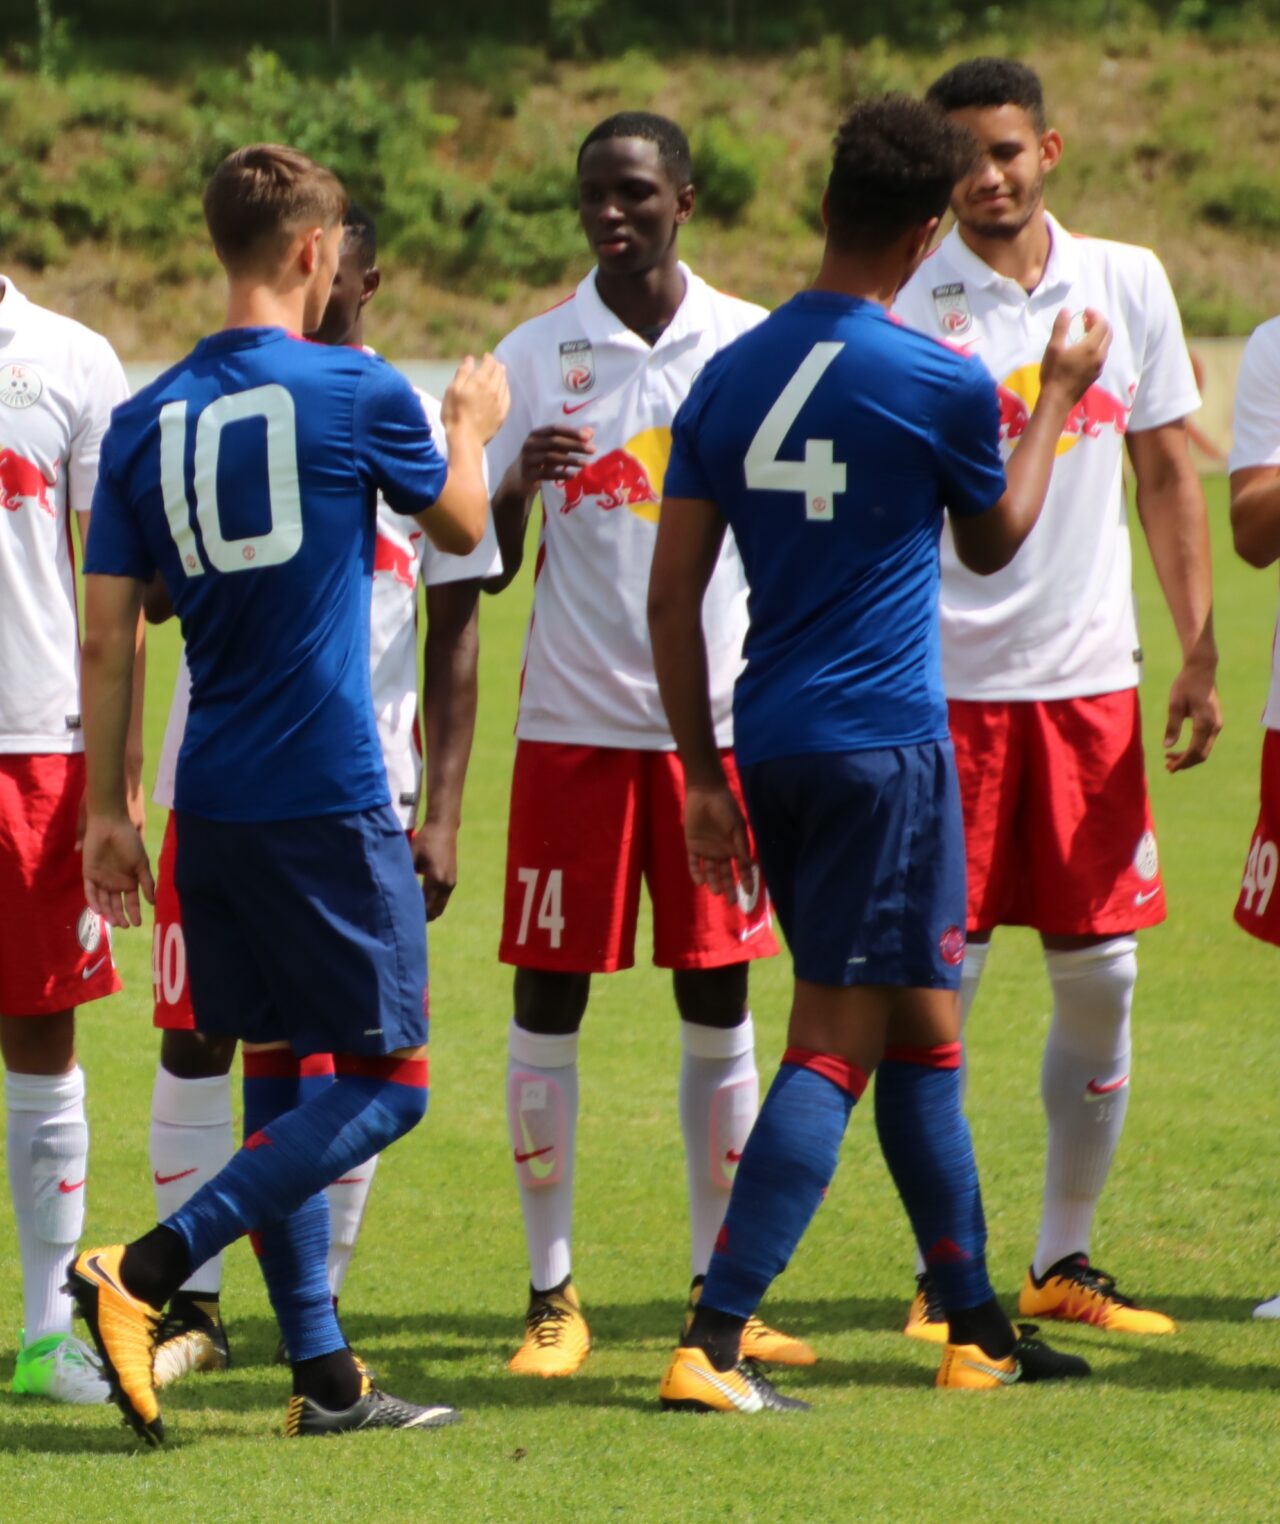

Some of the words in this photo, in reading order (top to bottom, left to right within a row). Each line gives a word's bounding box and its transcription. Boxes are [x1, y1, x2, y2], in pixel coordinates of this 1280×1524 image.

[159, 383, 303, 578] 10
[744, 341, 847, 520] 4
[516, 867, 565, 949] 74
[1242, 835, 1279, 916] 49
